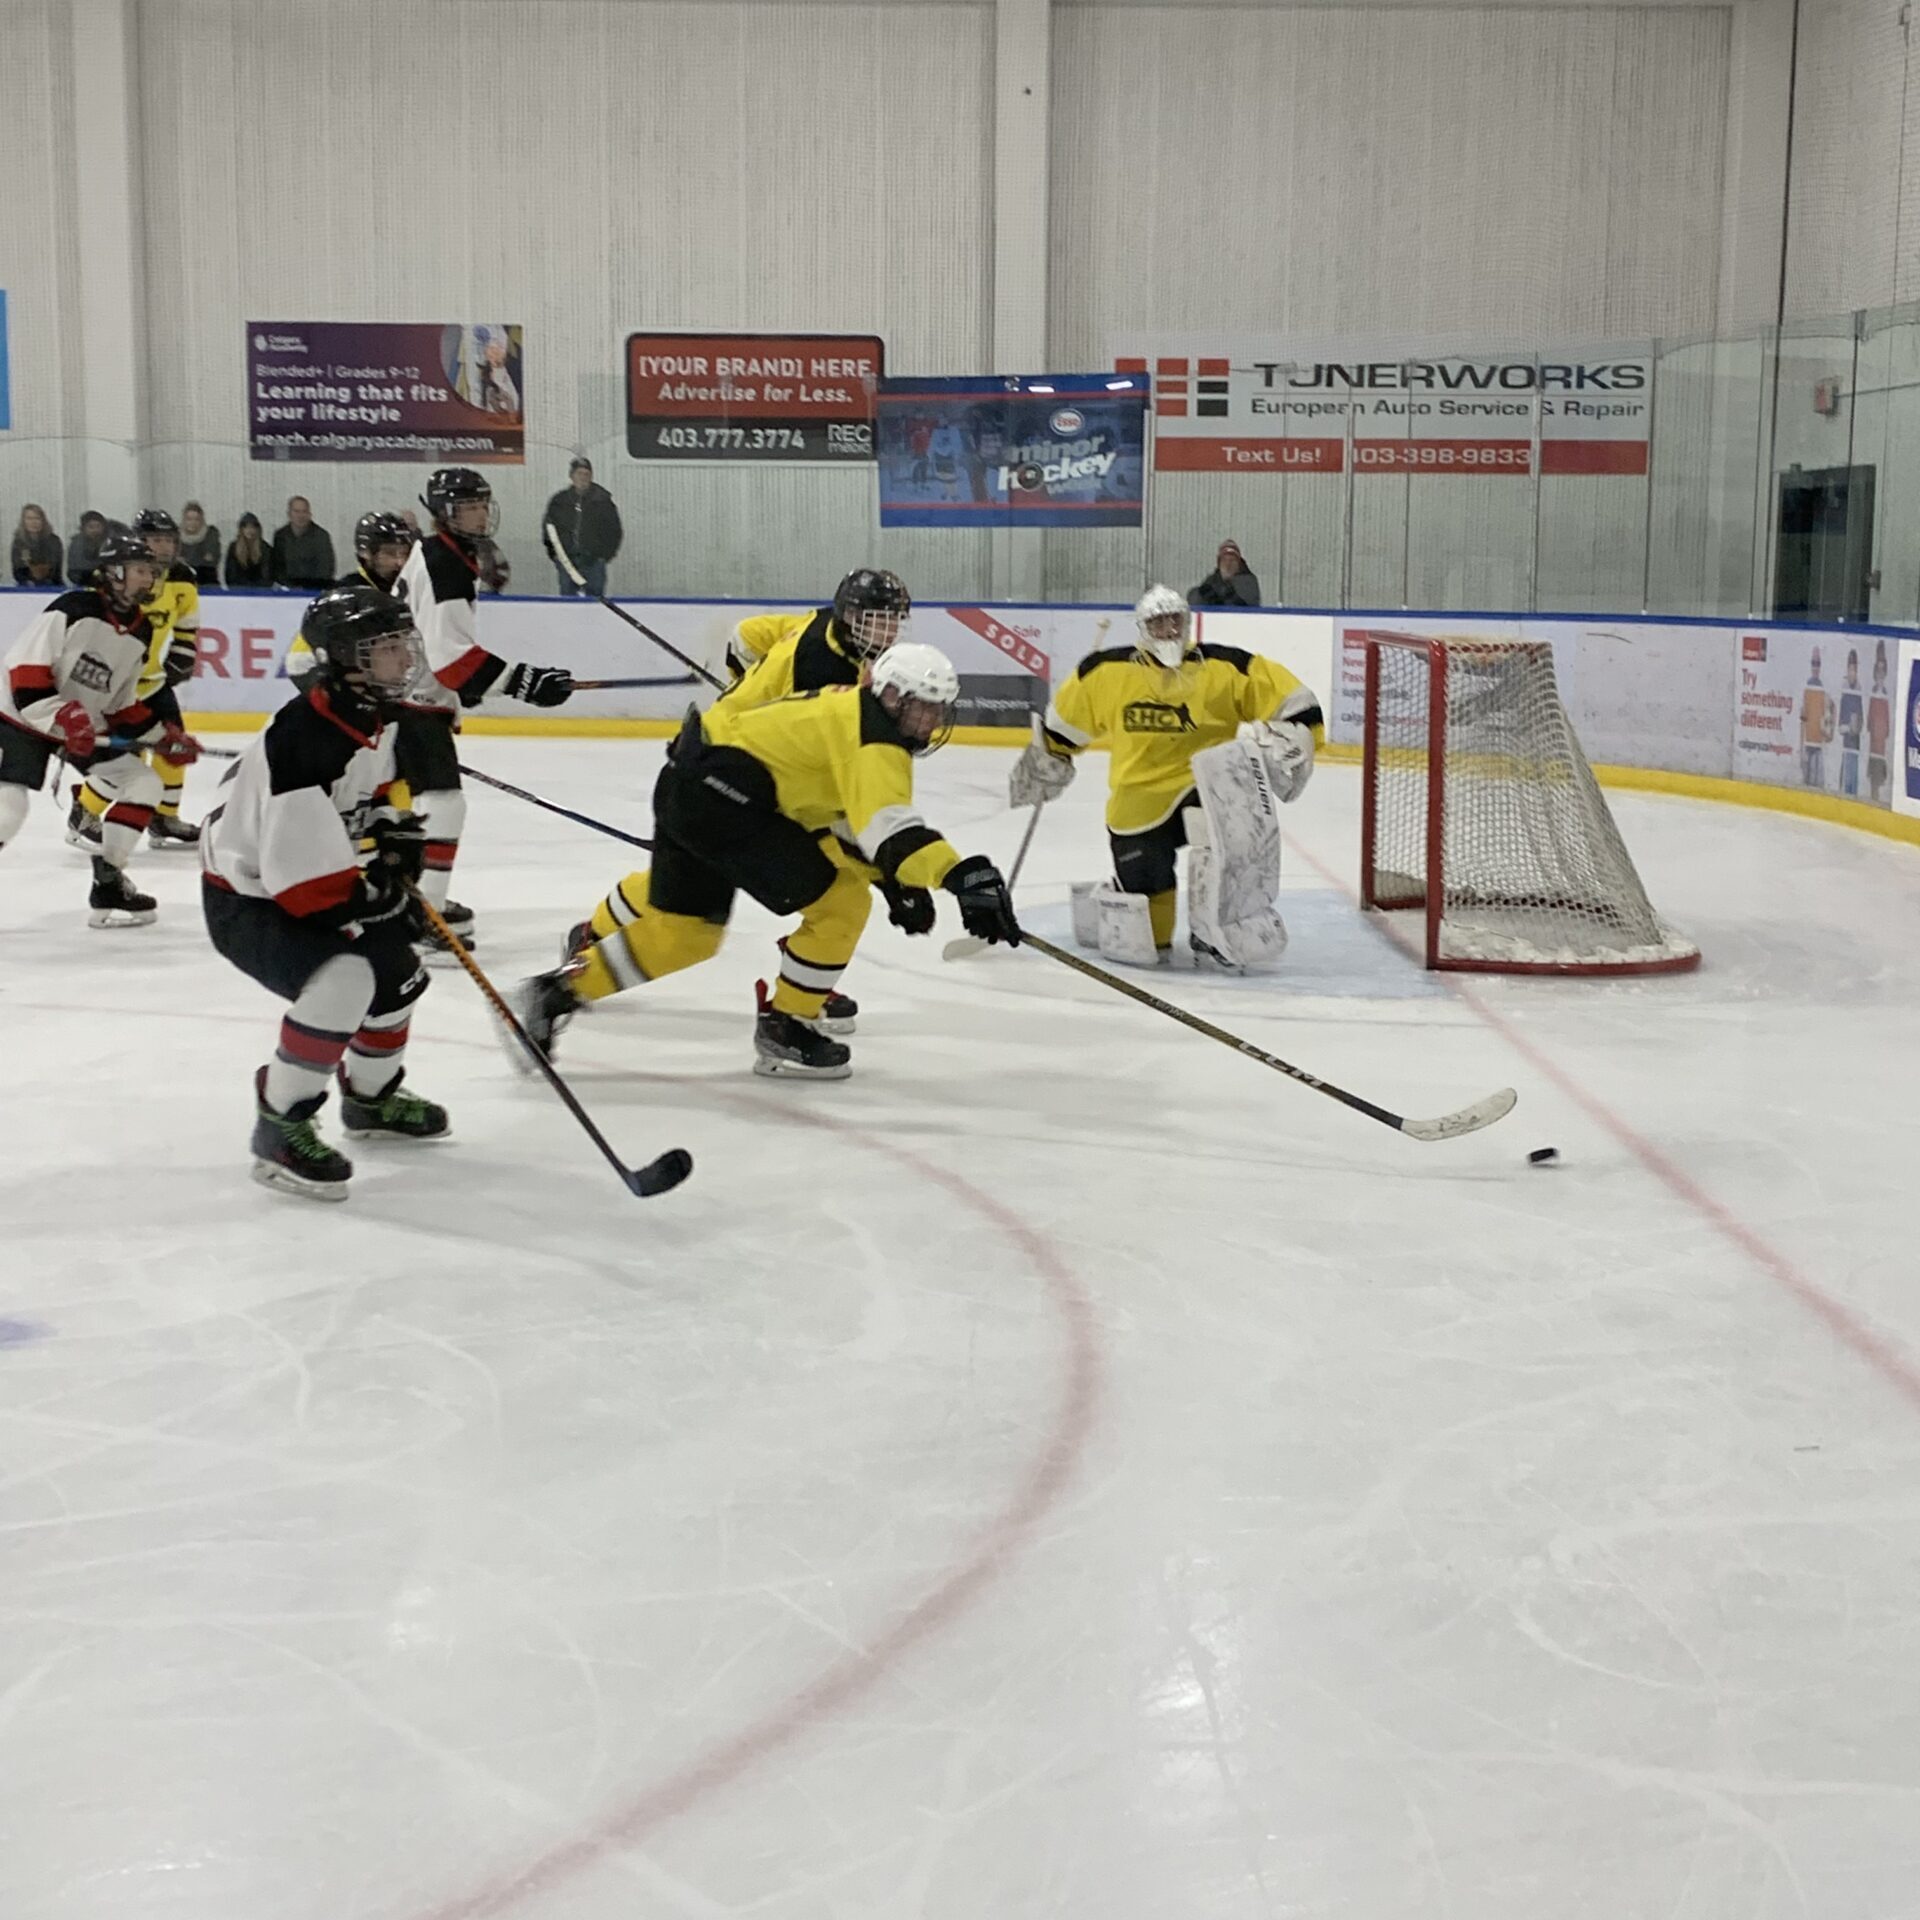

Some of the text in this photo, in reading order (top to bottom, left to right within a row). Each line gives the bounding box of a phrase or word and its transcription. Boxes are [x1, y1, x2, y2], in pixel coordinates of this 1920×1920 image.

[336, 365, 387, 379] Grades
[388, 366, 420, 379] 9-12
[639, 356, 709, 378] [YOUR
[715, 358, 804, 379] BRAND]
[256, 382, 449, 403] Learning that fits
[658, 383, 853, 402] Advertise for Less.
[256, 404, 402, 425] your lifestyle
[1252, 399, 1366, 419] European
[1373, 400, 1432, 416] Auto
[1439, 400, 1530, 416] Service
[1564, 401, 1645, 421] Repair
[255, 433, 495, 451] reach.calgaryacademy.com
[657, 424, 872, 449] 403.777.3774 REC
[1222, 446, 1276, 464] Text
[1282, 446, 1322, 464] Us!
[984, 623, 1045, 671] SOLD
[1741, 668, 1758, 690] Try
[1741, 690, 1793, 715] something
[1741, 709, 1783, 731] different
